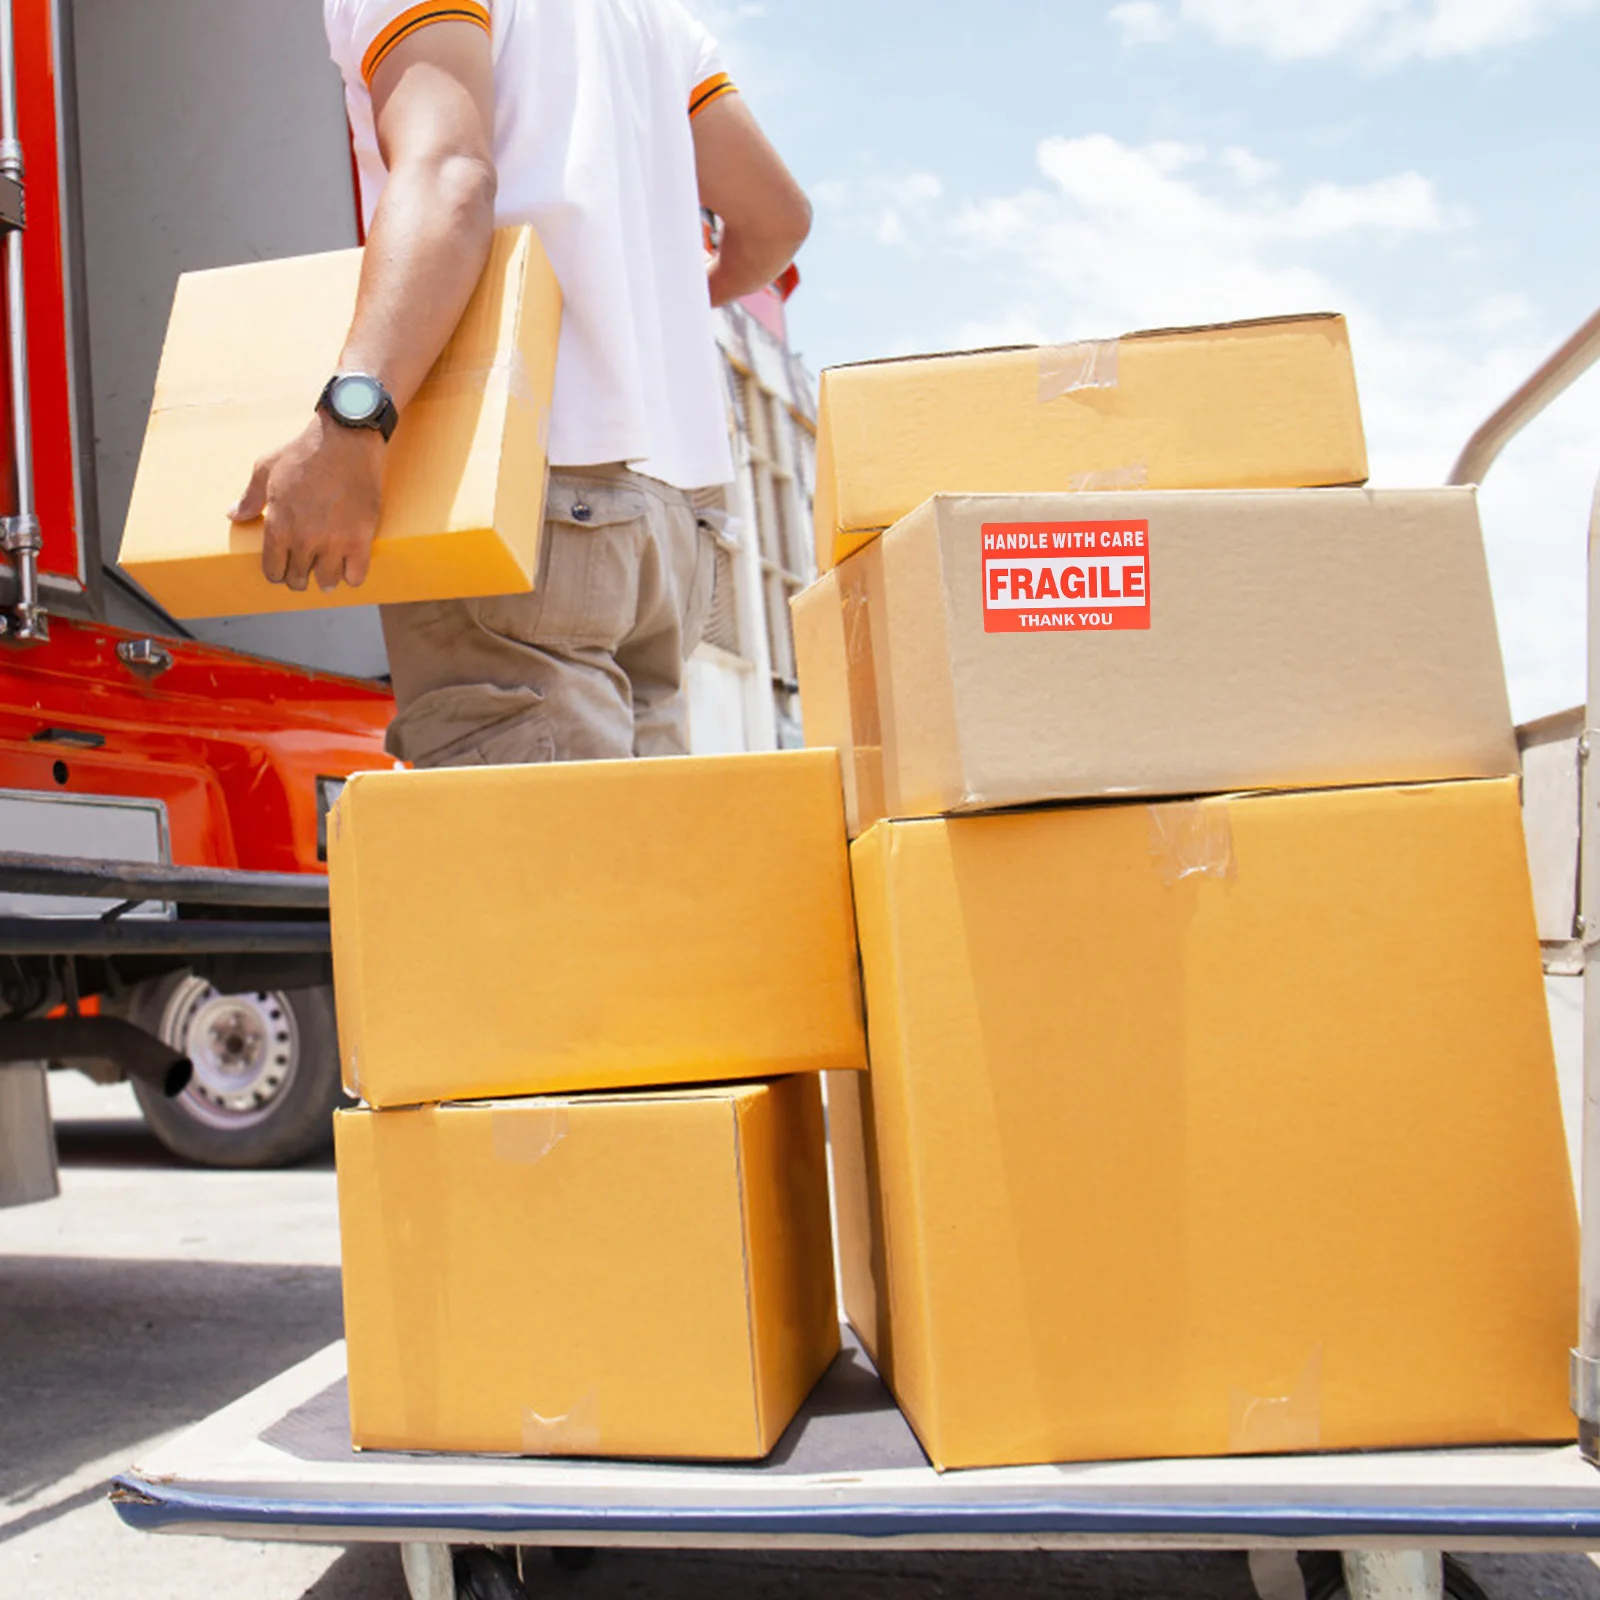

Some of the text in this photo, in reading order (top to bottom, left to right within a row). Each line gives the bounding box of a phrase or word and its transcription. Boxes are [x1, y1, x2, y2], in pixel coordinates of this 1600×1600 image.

[984, 531, 1145, 550] HANDLE WITH CARE
[989, 565, 1144, 600] FRAGILE
[1018, 613, 1113, 627] THANK YOU
